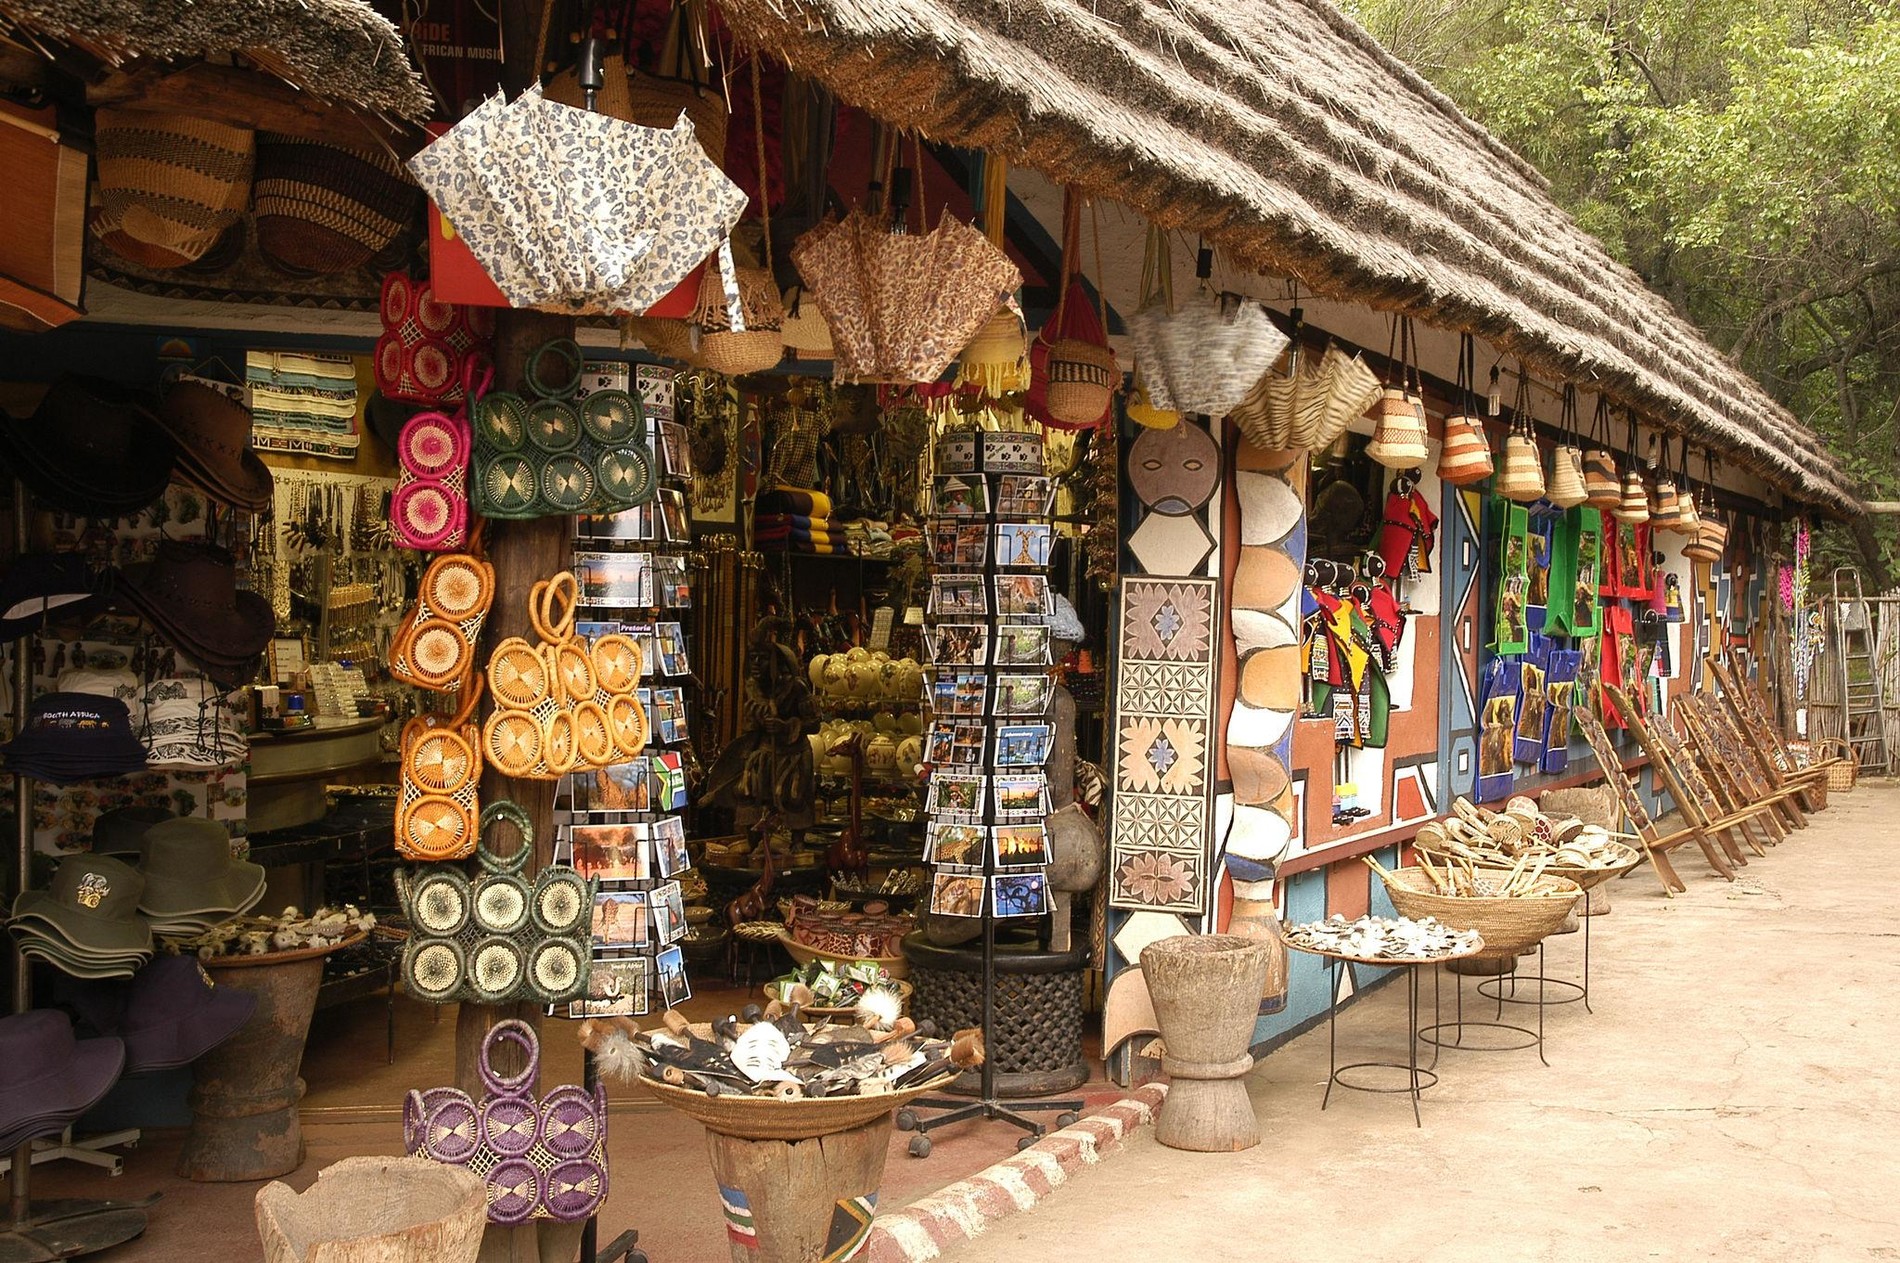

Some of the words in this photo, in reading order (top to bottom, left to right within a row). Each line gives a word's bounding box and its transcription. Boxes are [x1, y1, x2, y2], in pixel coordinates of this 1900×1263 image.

[422, 44, 463, 58] FRICAN
[620, 624, 651, 632] Pretoria
[43, 711, 69, 719] SOUTH
